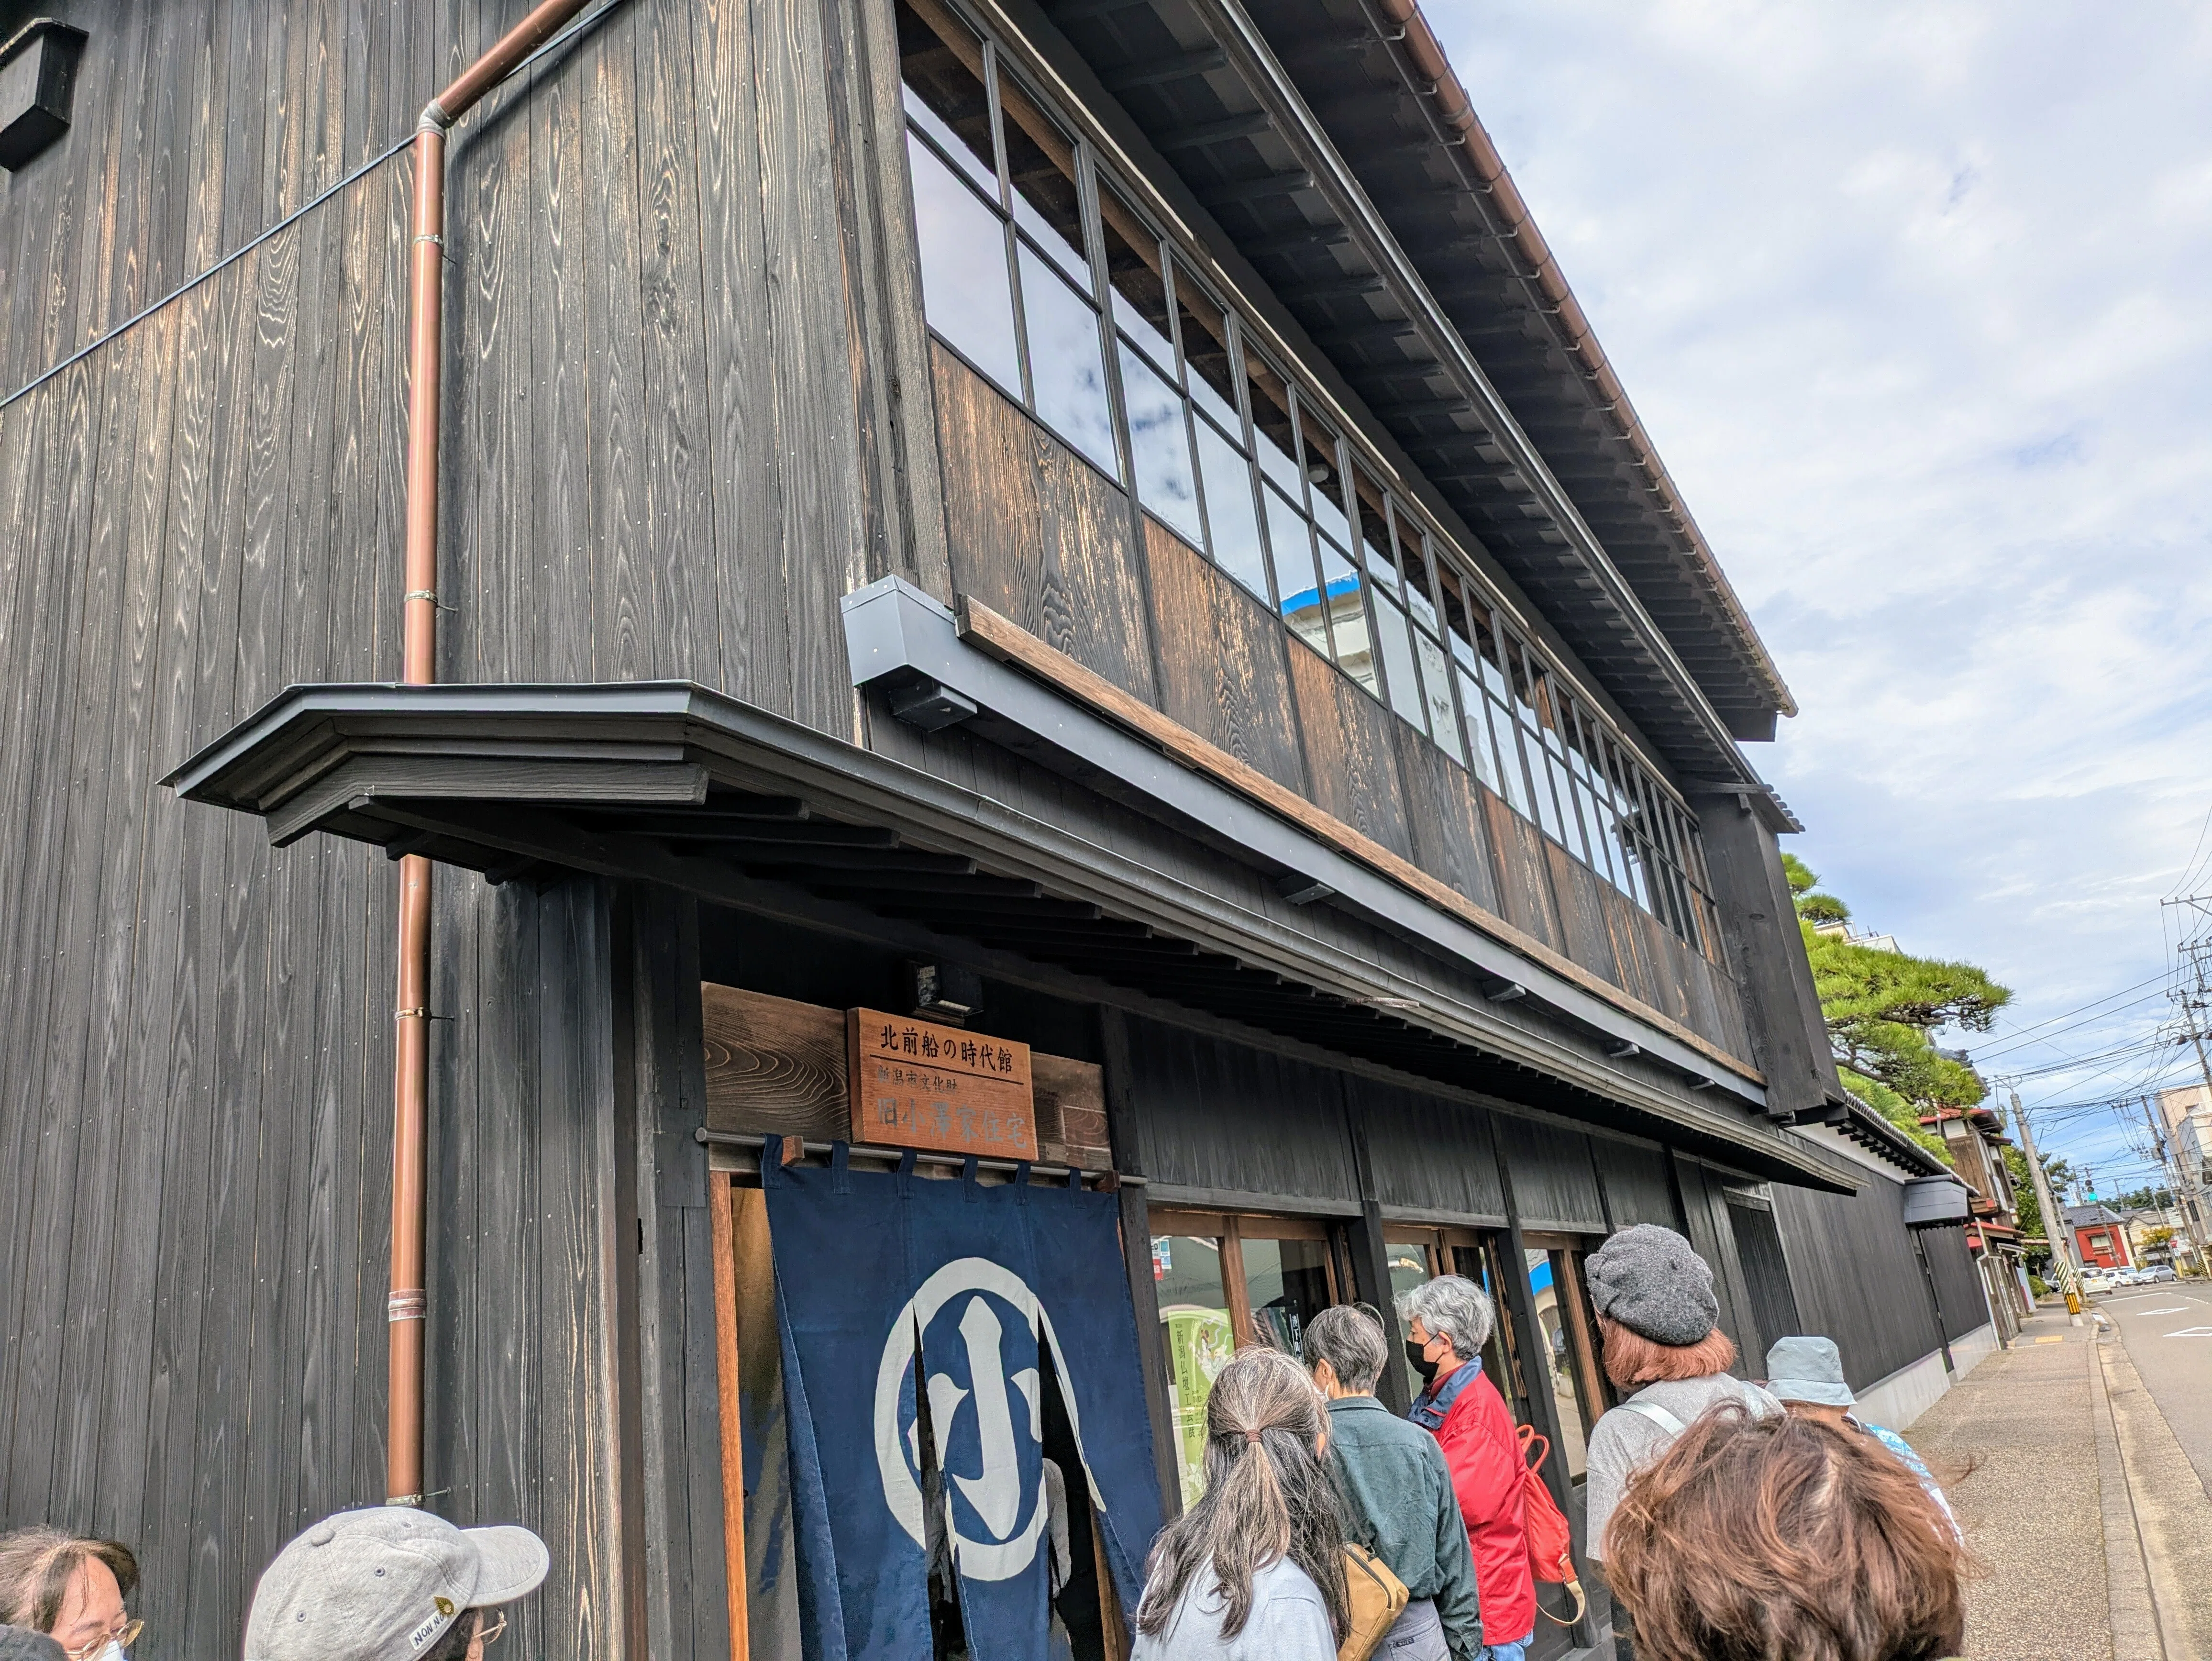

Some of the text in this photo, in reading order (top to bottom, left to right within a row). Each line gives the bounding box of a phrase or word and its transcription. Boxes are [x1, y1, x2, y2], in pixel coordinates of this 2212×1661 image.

[881, 1024, 1013, 1074] 北前船の時代館
[877, 1098, 1027, 1148] 旧小澤家住宅
